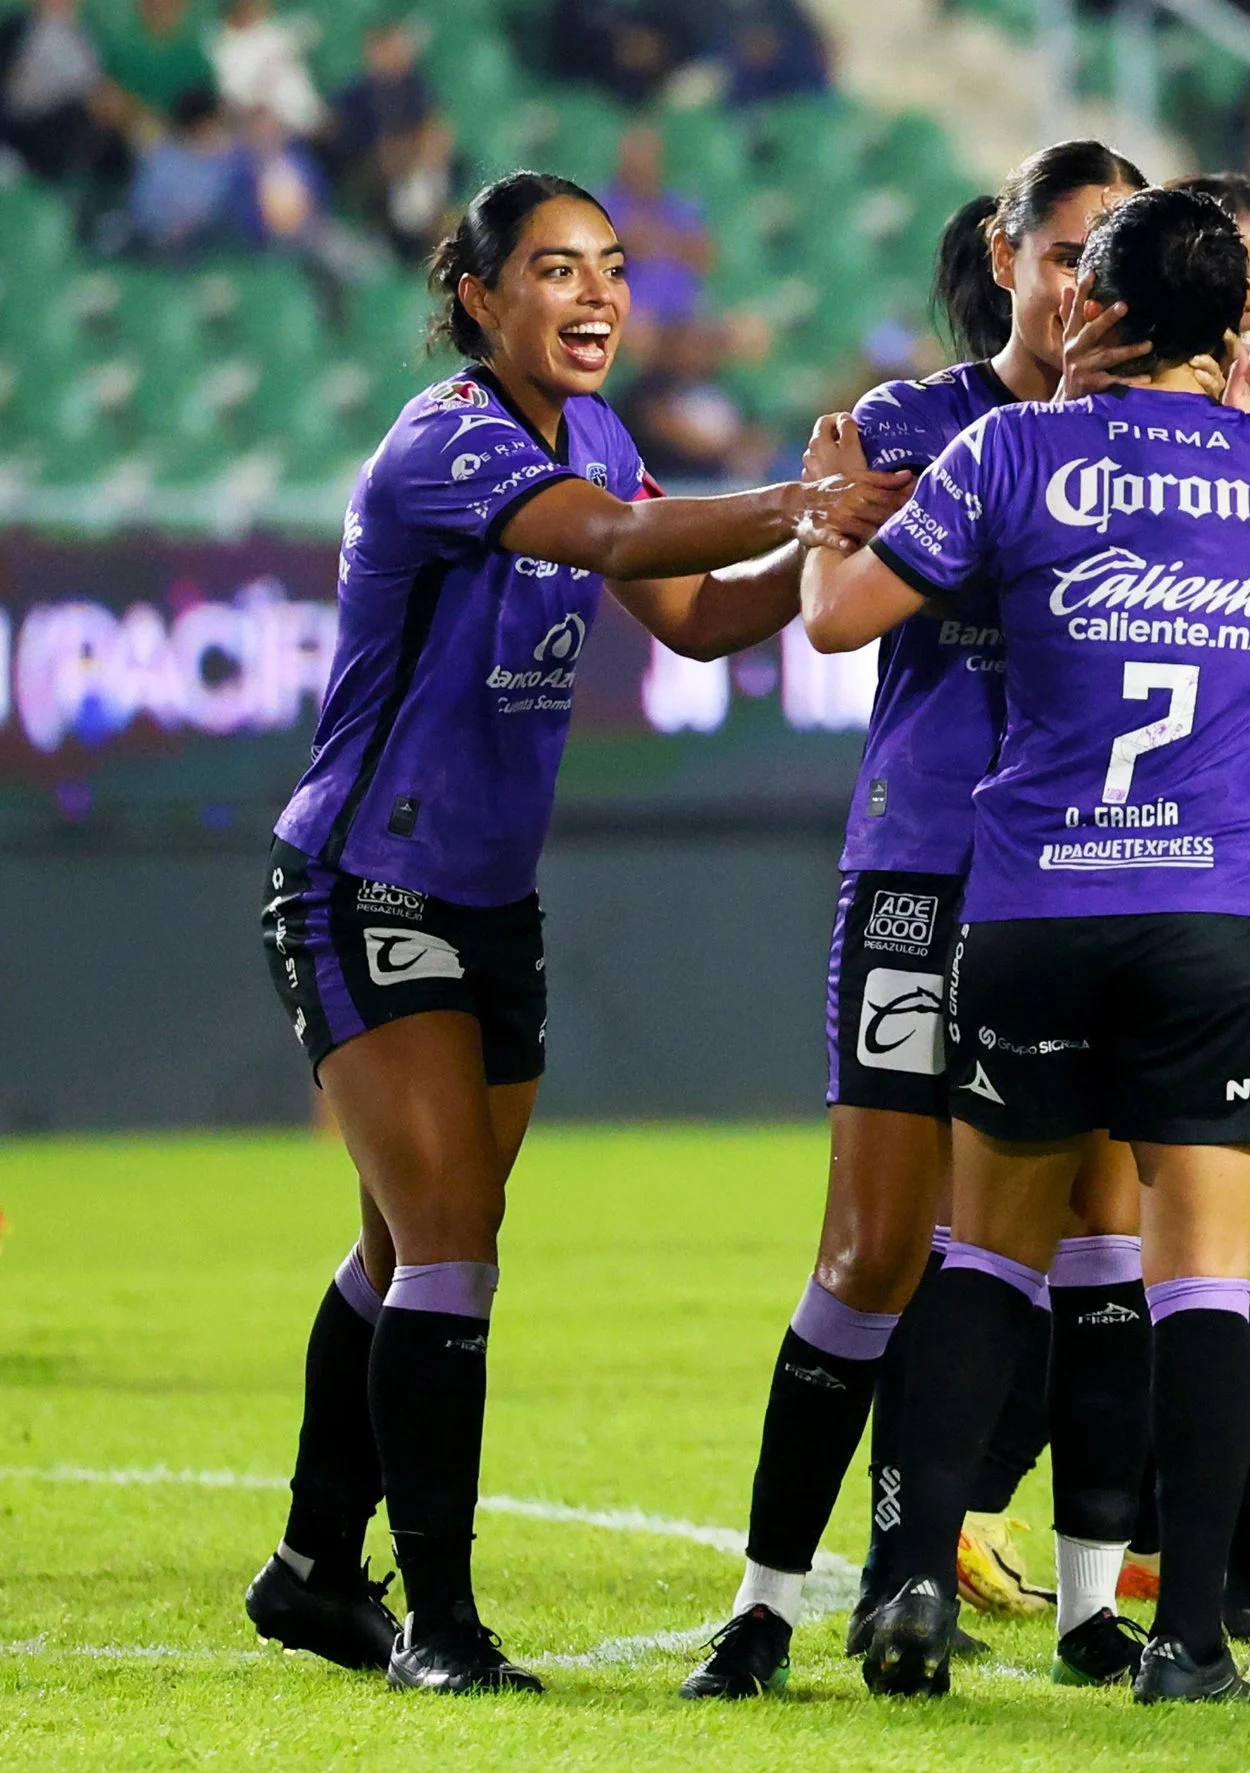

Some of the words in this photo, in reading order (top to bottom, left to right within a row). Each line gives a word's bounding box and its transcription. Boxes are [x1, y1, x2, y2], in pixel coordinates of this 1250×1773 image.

[1107, 420, 1231, 450] PIRMA
[900, 514, 943, 556] VATOR
[908, 499, 949, 541] RSSON
[1102, 661, 1200, 804] 7
[1094, 797, 1180, 829] GARCÍA
[1059, 835, 1215, 861] PAQUETEXPRESS
[878, 896, 932, 919] ADE
[869, 917, 928, 941] 1000
[863, 940, 929, 957] PEGAZULEJO
[949, 941, 964, 1017] GRUPO
